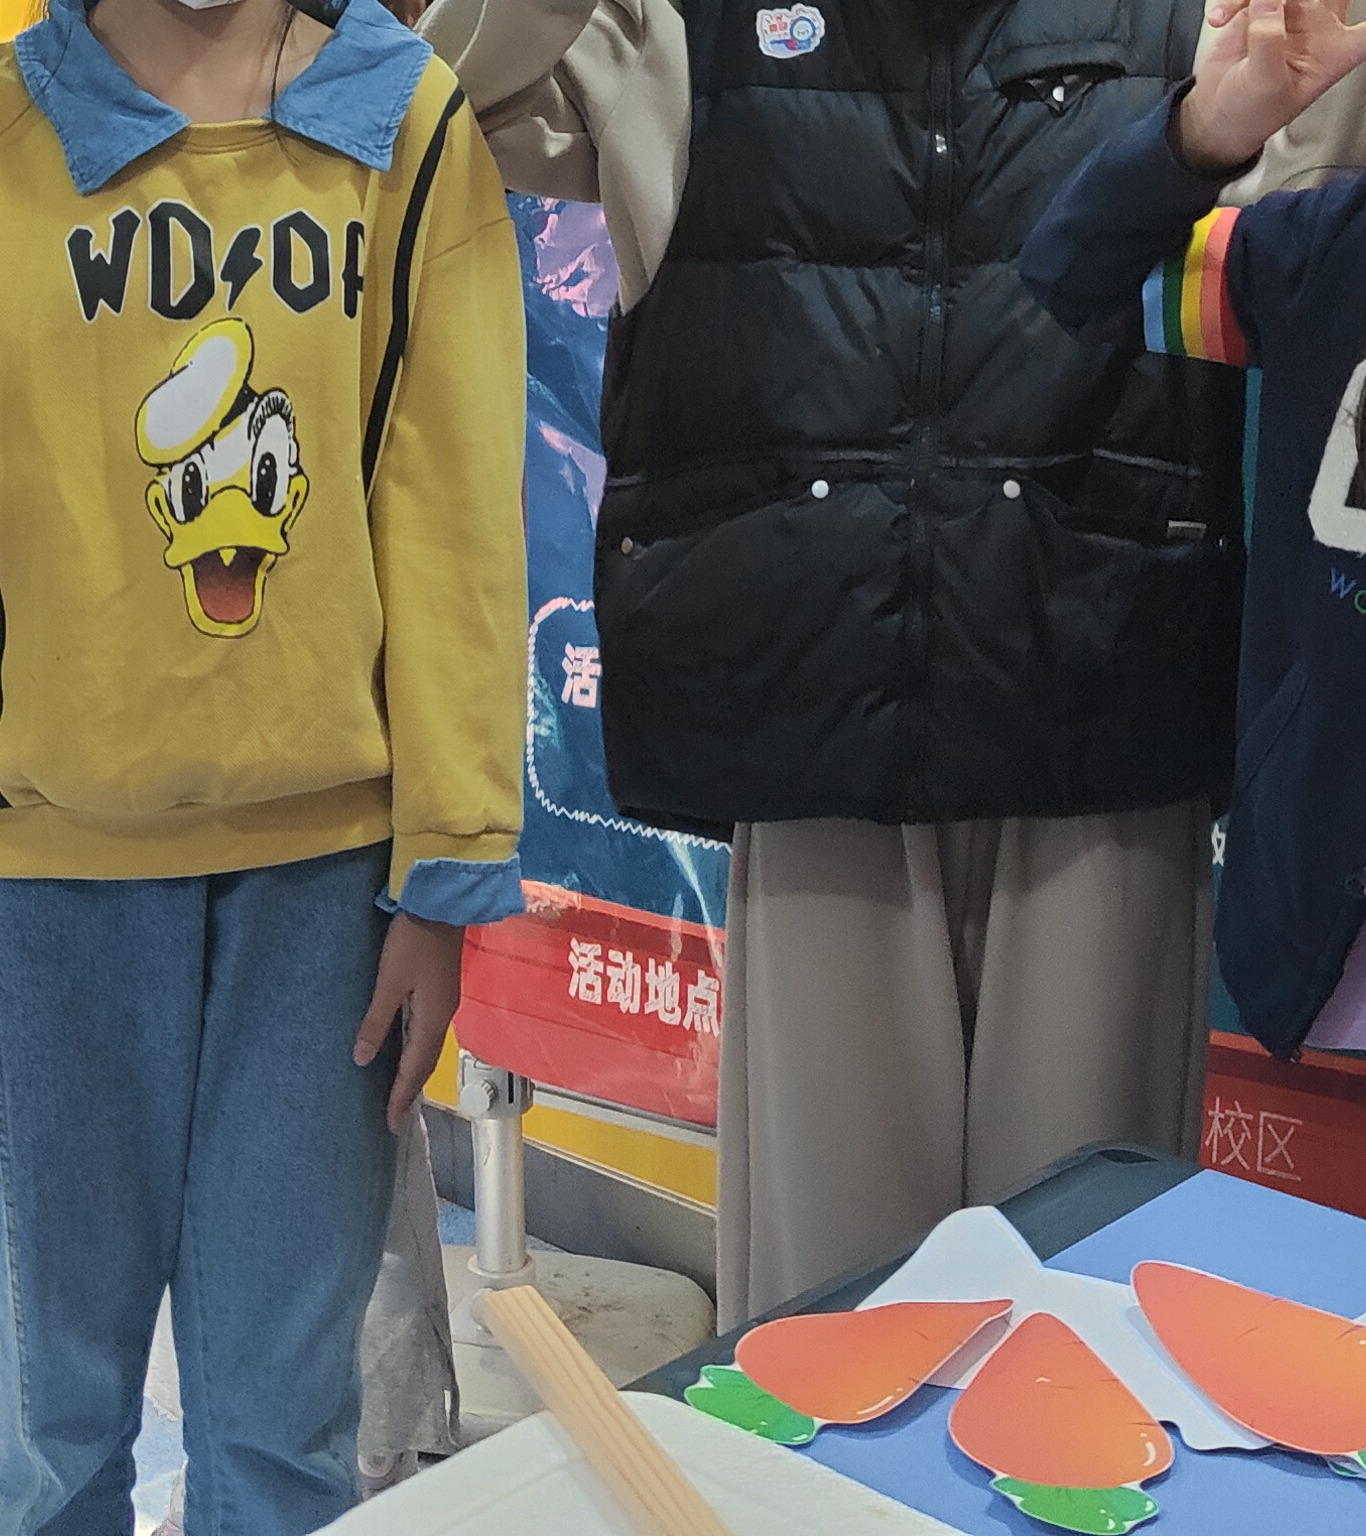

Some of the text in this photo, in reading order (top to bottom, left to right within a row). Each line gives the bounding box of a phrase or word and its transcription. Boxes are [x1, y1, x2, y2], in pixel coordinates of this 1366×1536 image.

[567, 936, 721, 1039] 活动地点
[1204, 1095, 1304, 1182] 校区
